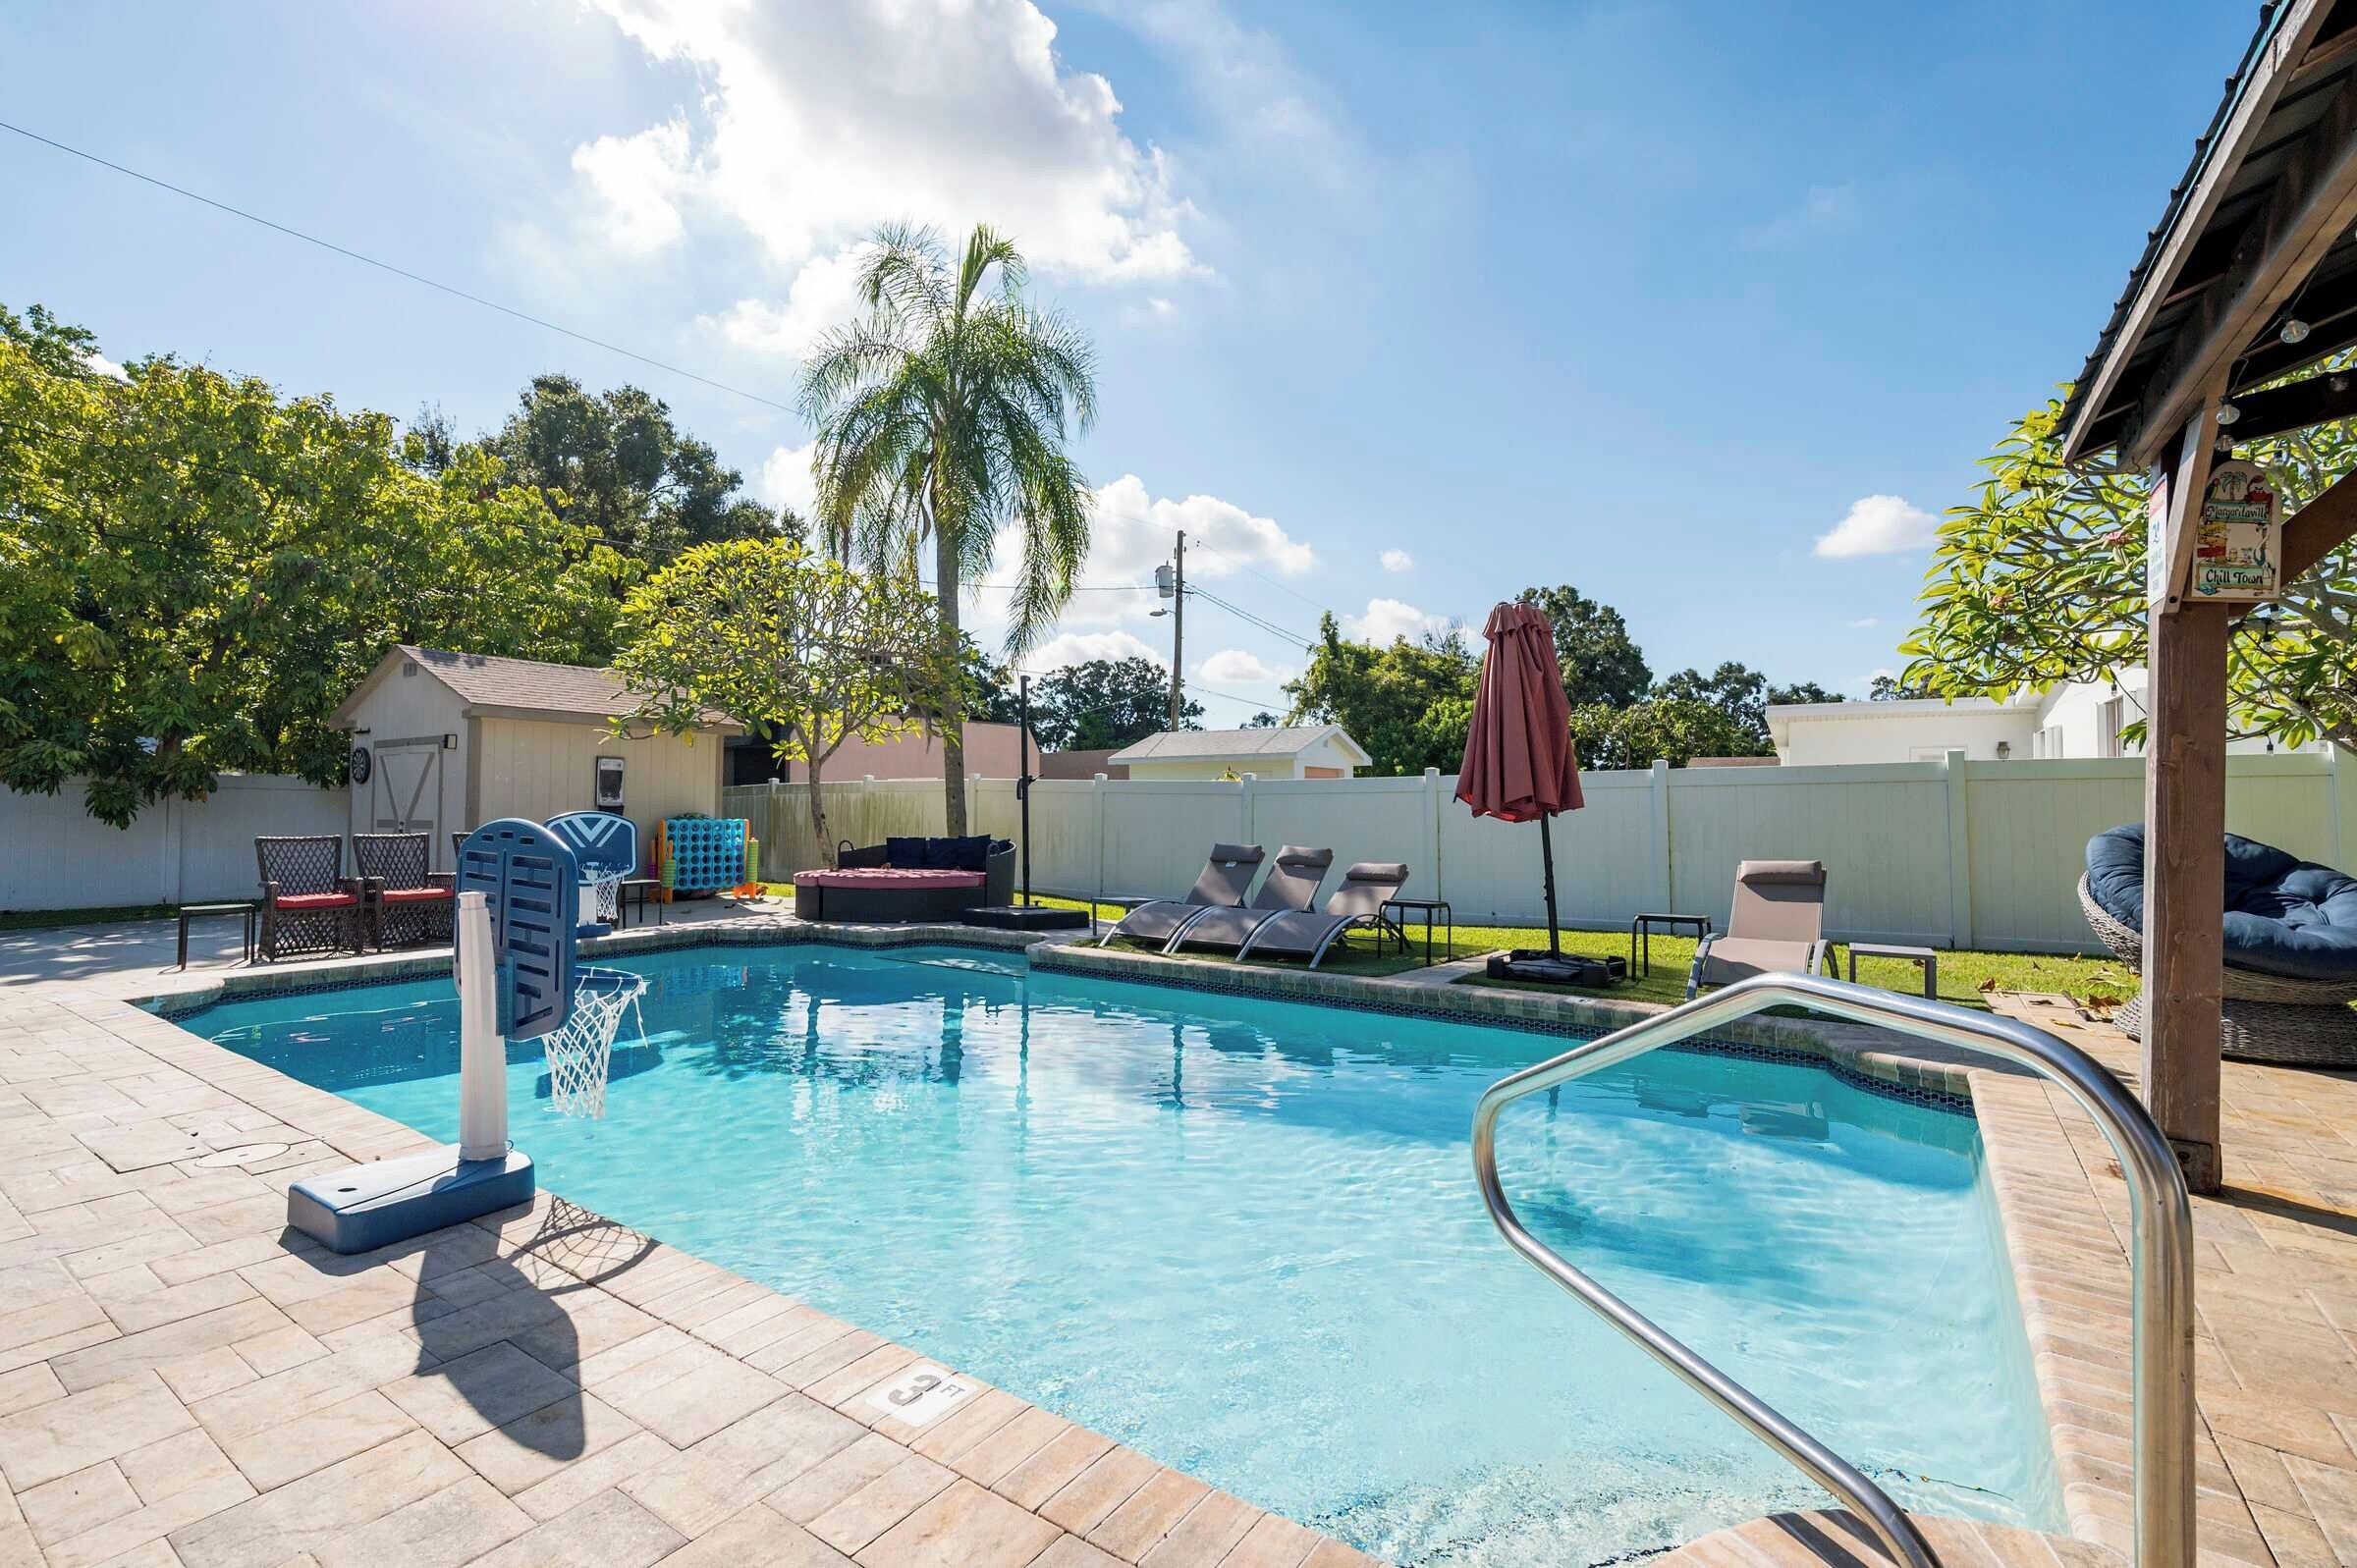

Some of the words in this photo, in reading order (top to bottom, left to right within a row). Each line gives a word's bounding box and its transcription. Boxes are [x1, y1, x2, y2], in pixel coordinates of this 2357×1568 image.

[2206, 568, 2230, 585] Chill
[2233, 571, 2264, 584] Town
[888, 1375, 942, 1406] 3
[940, 1383, 965, 1397] FT
